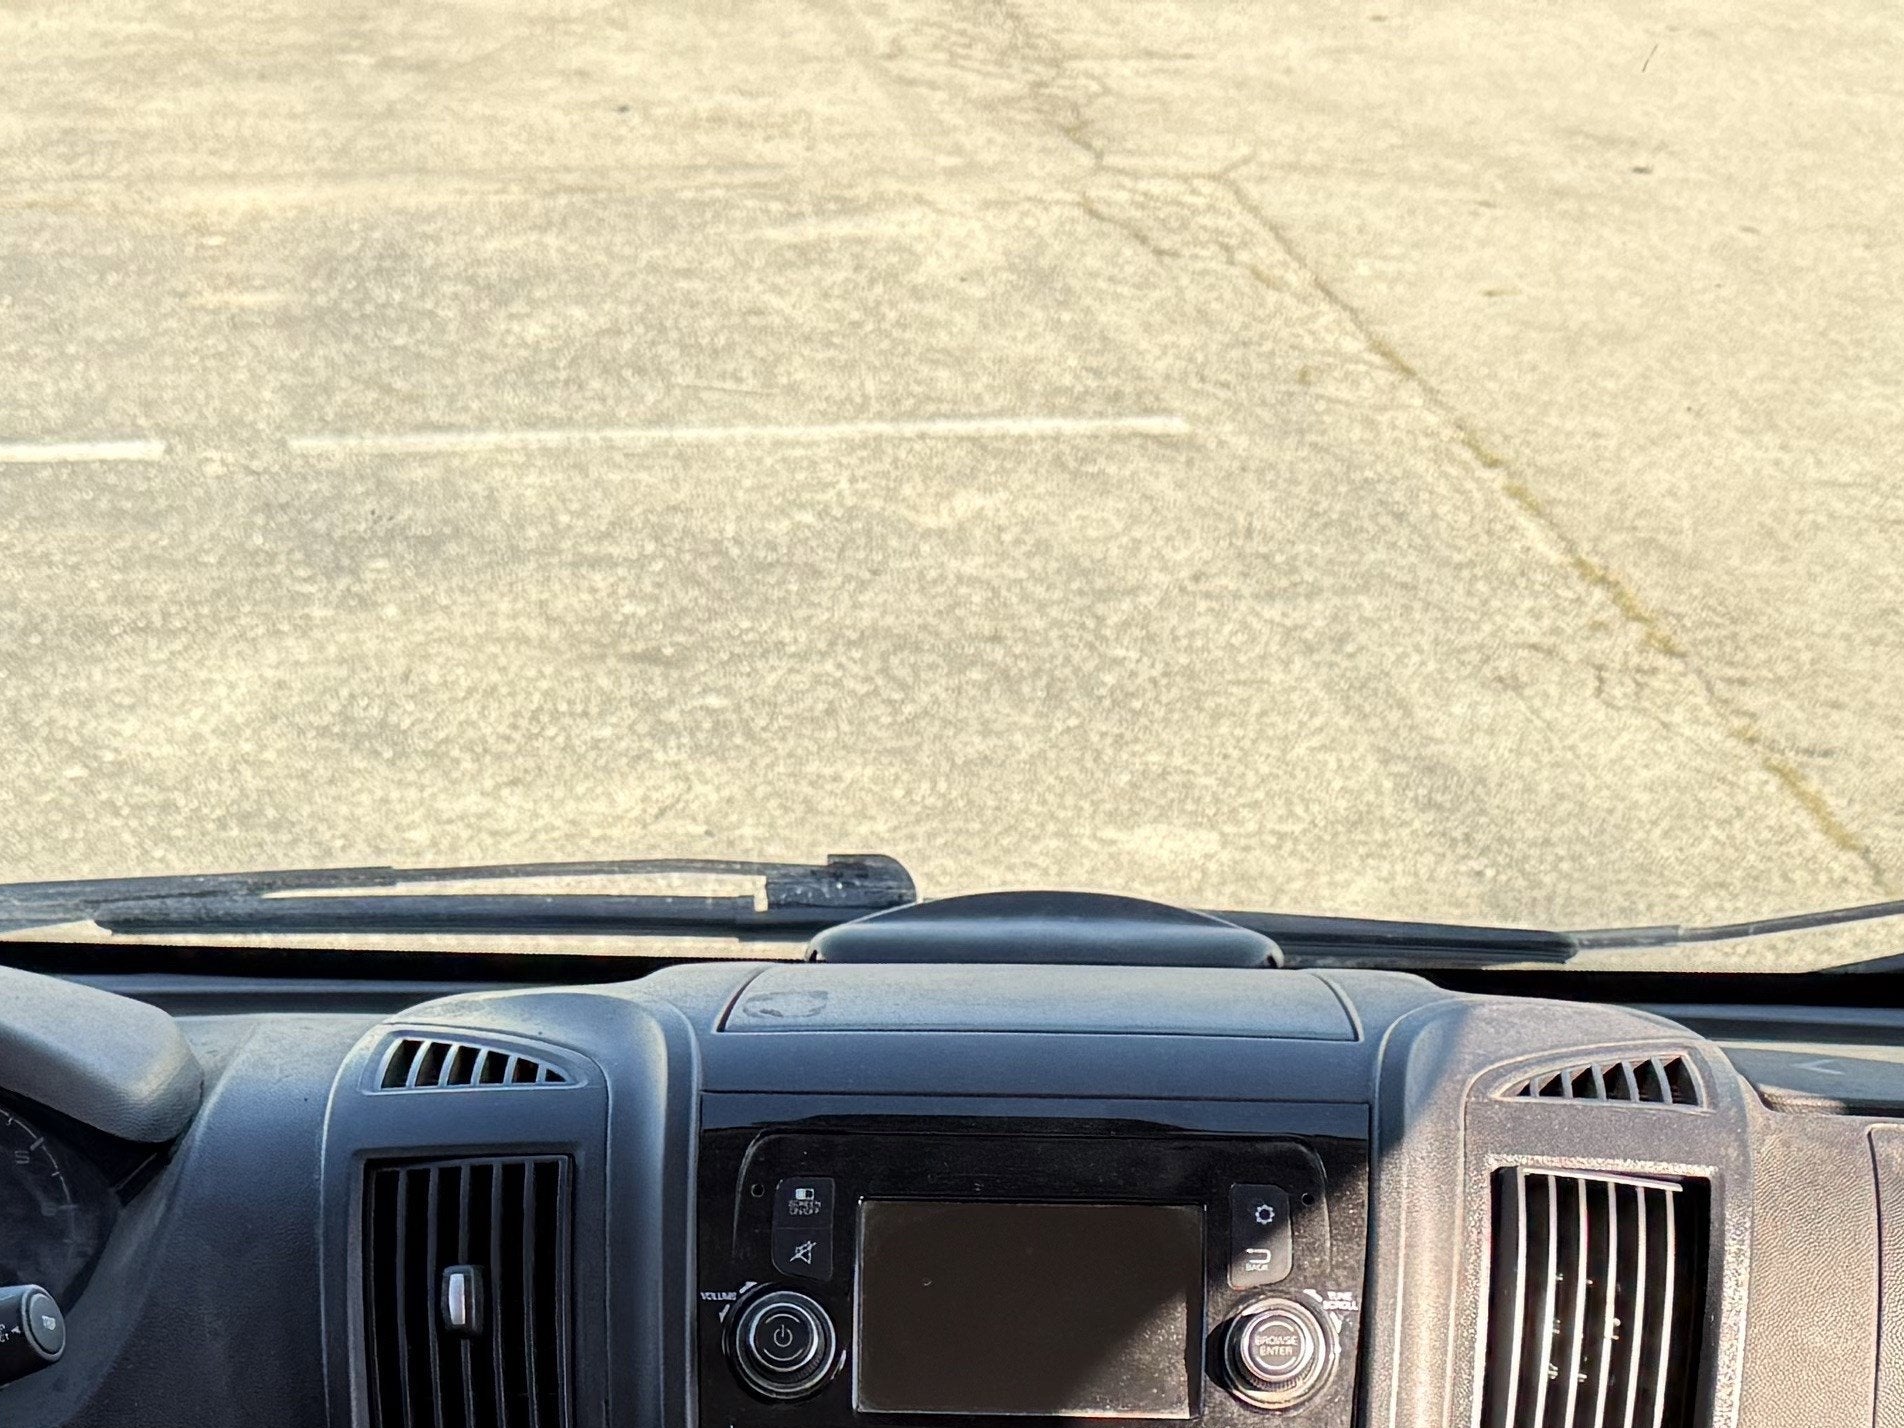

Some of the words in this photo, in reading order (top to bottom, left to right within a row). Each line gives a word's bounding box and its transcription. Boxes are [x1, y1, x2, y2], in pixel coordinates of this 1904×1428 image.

[1322, 1301, 1358, 1311] SCROLL
[1255, 1335, 1298, 1346] BROWSE
[1260, 1345, 1293, 1356] ENTER
